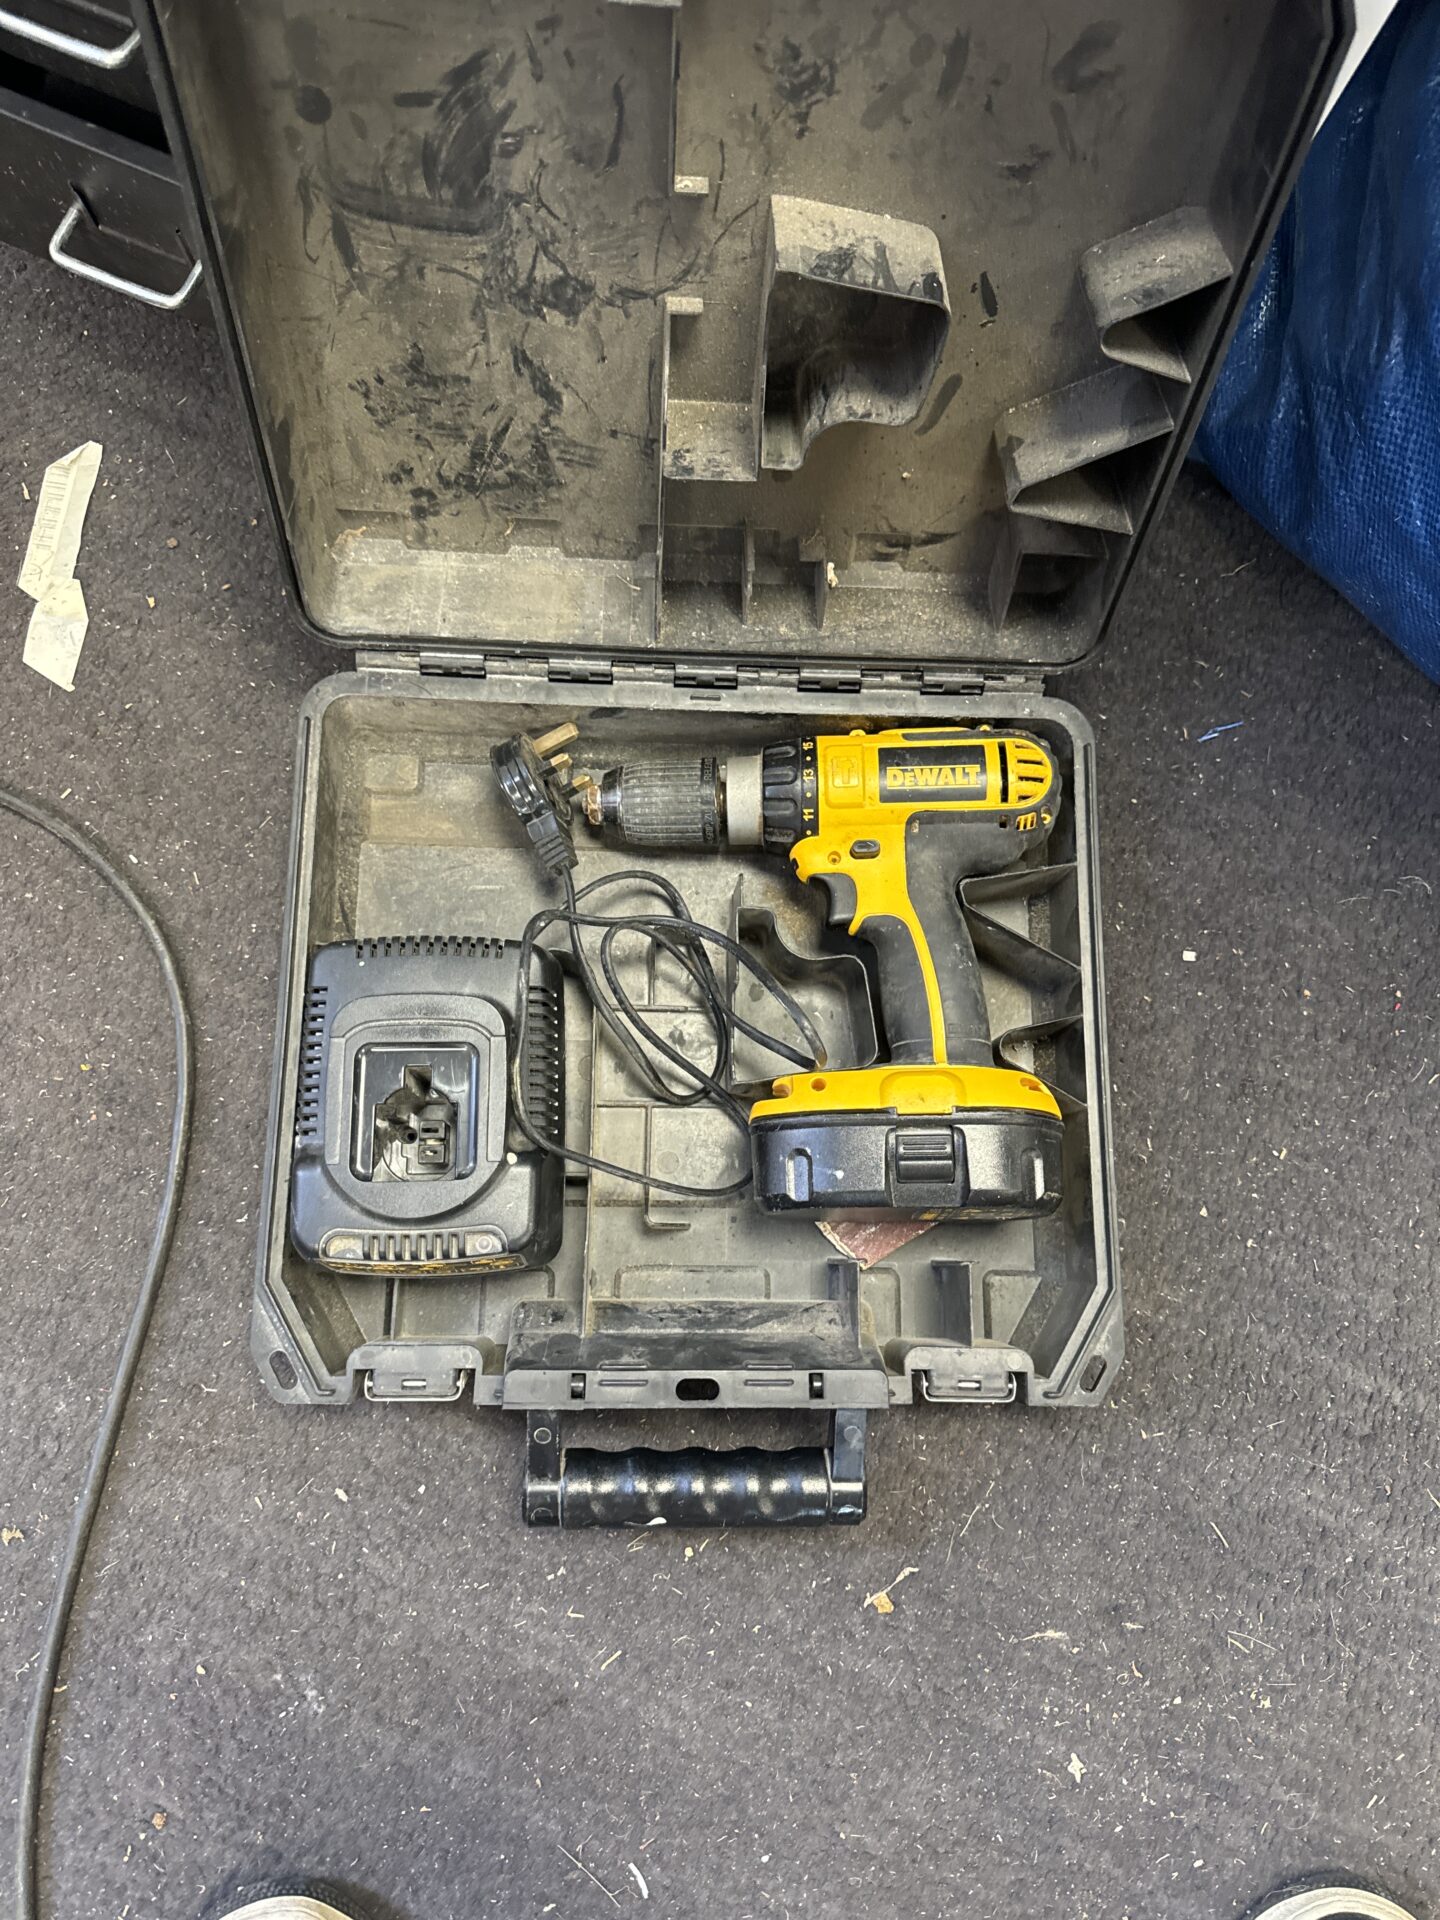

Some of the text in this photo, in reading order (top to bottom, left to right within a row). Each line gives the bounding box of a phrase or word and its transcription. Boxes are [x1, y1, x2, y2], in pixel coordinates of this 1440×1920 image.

[802, 741, 814, 822] 11 13 15
[886, 766, 981, 788] DEWALT
